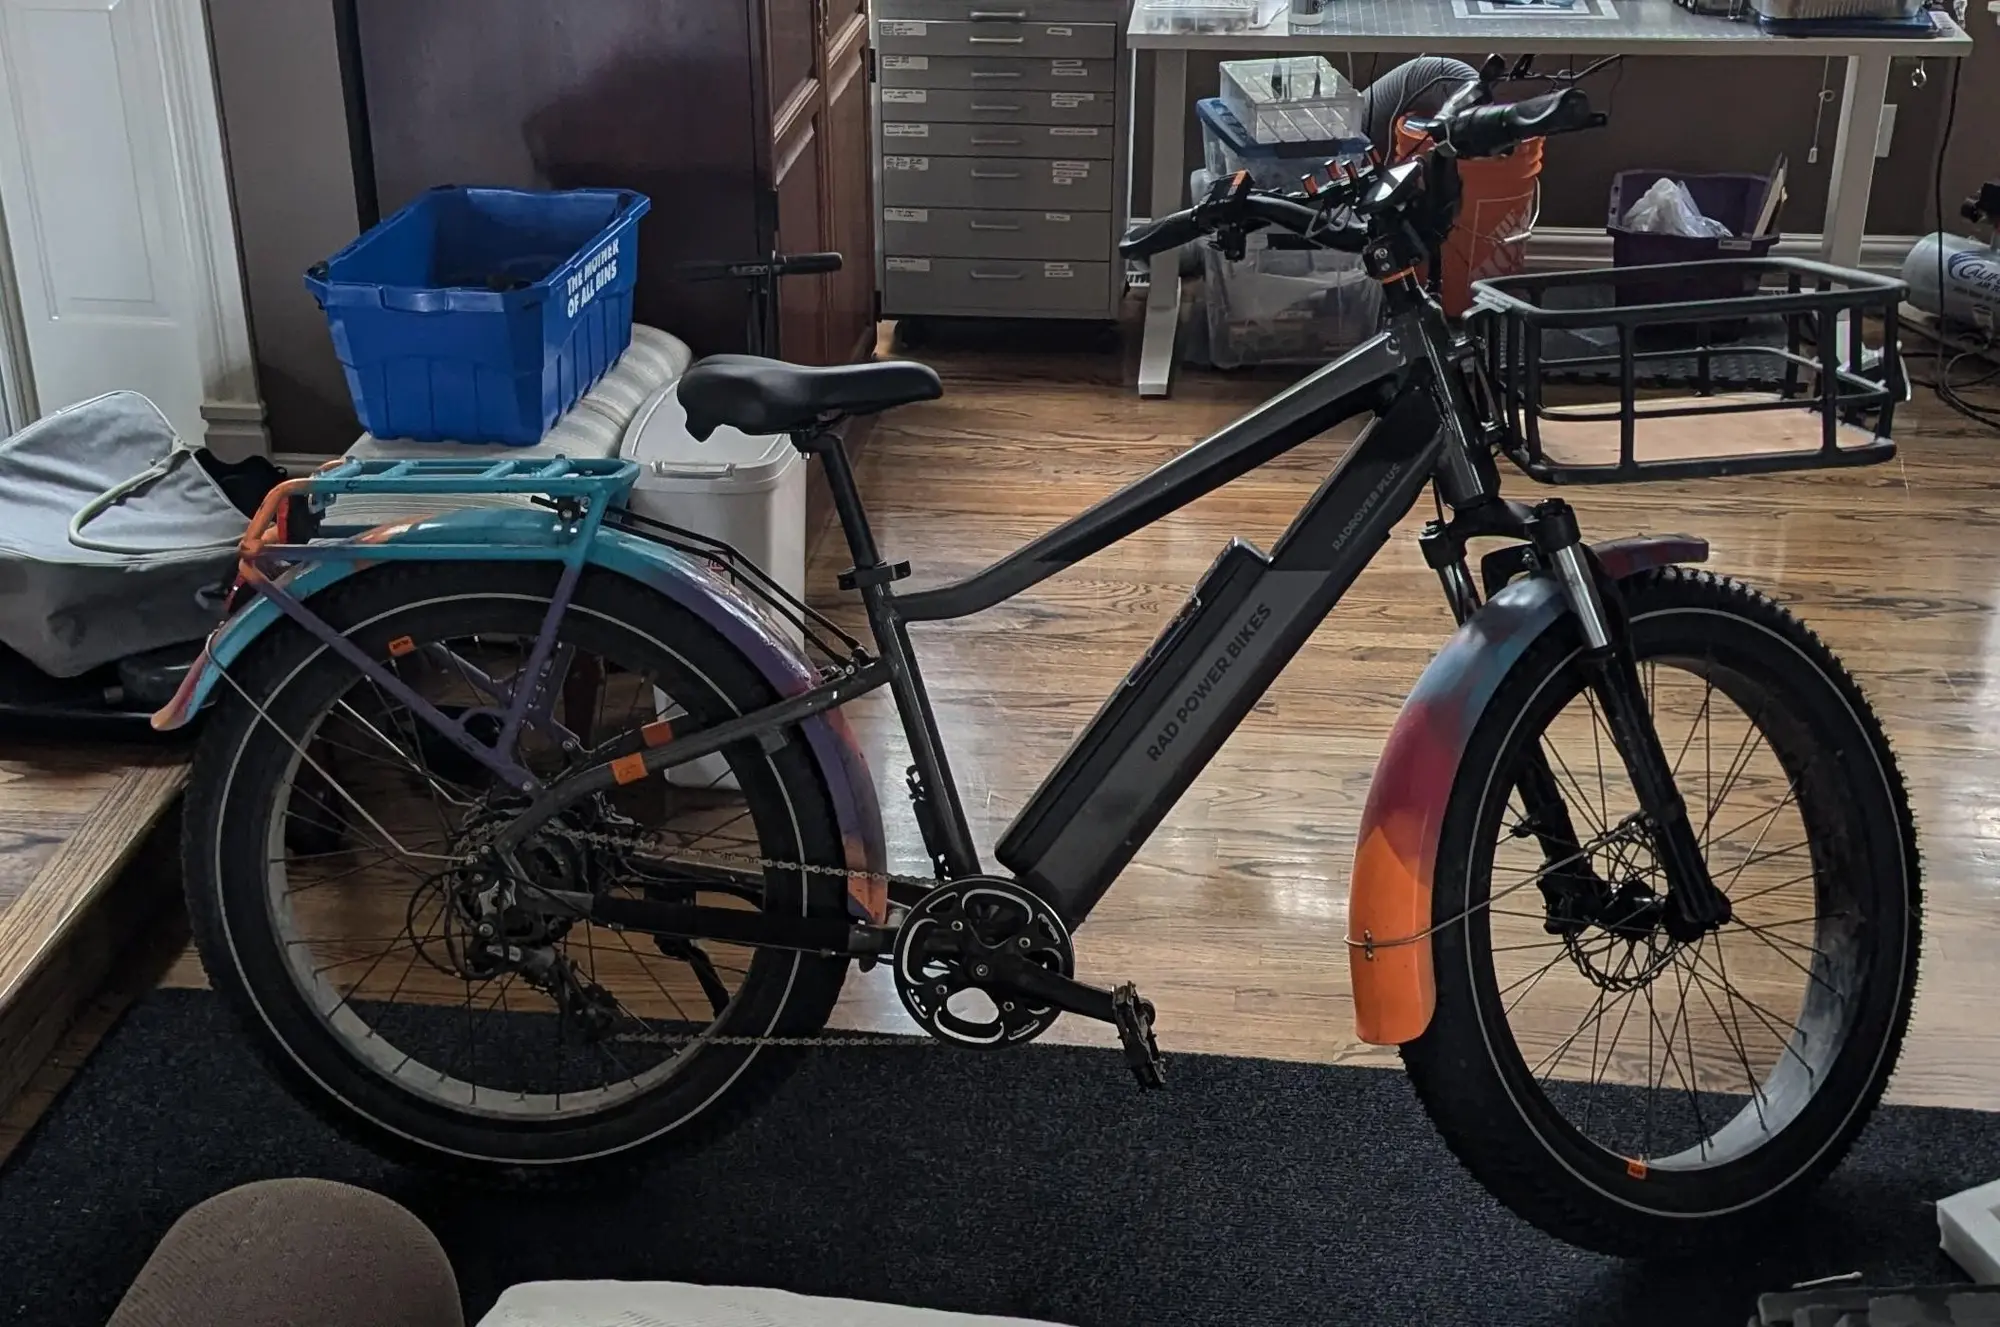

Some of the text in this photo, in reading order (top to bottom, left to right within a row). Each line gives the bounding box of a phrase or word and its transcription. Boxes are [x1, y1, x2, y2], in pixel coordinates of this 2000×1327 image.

[567, 237, 619, 296] THE MOTHER
[567, 259, 617, 318] OF ALL BINS
[1332, 462, 1401, 551] RADROVER PLUS
[1146, 603, 1272, 761] RAD POWER BIKES
